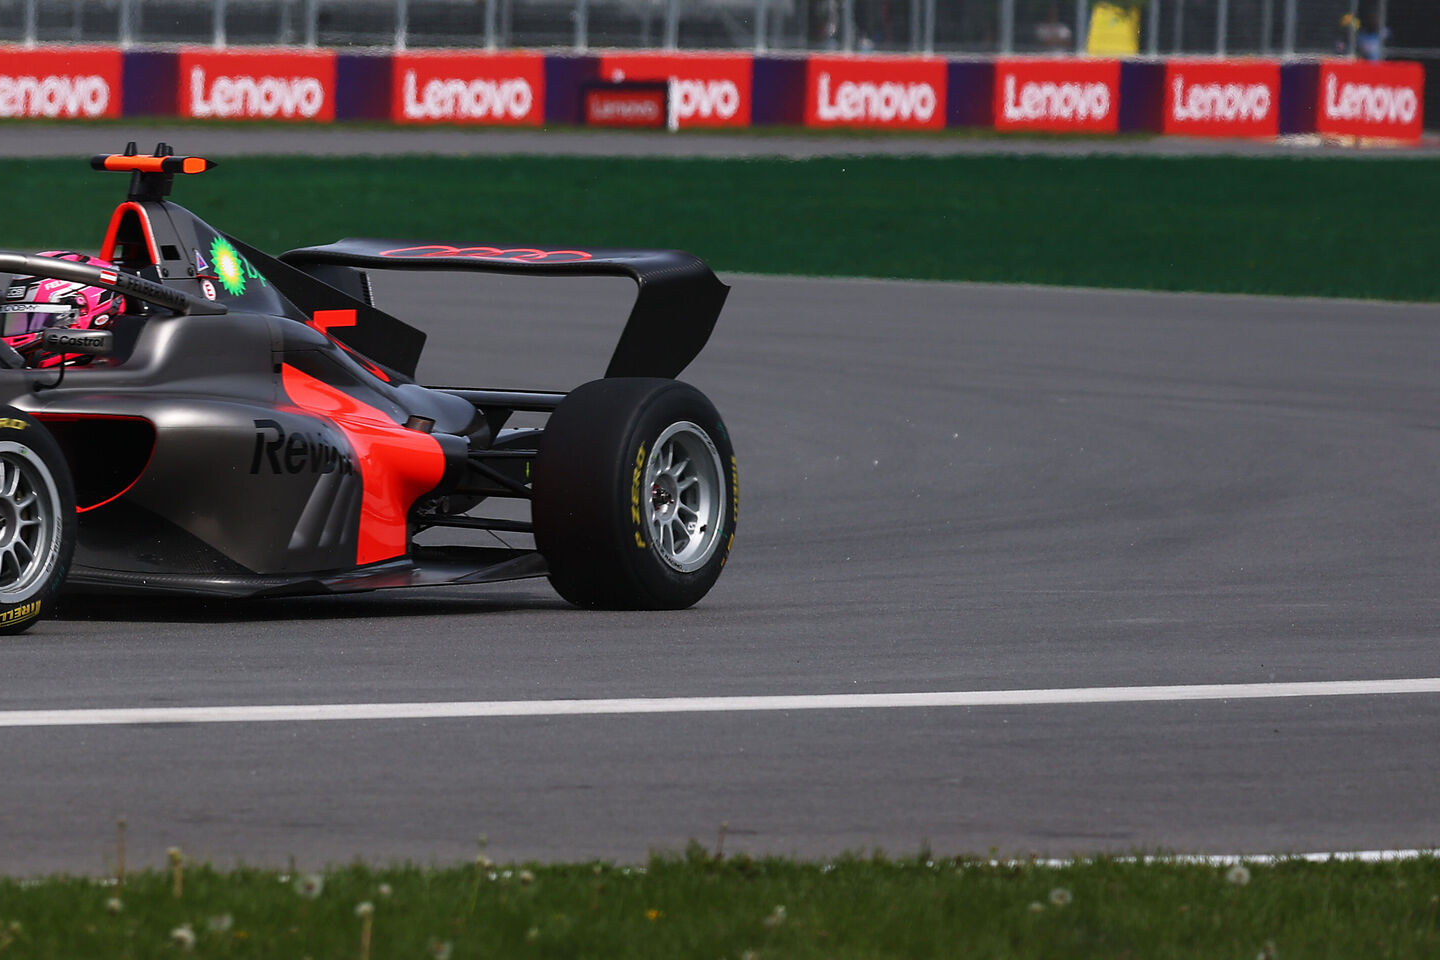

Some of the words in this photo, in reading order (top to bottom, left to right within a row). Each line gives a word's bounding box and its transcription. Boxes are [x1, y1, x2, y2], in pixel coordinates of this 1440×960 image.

[190, 68, 324, 118] Lenovo
[404, 72, 533, 119] Lenovo
[817, 74, 936, 121] Lenovo
[1004, 76, 1110, 121] Lenovo
[1173, 76, 1271, 121] Lenovo
[1326, 74, 1417, 123] Lenovo
[60, 335, 104, 347] Castrol
